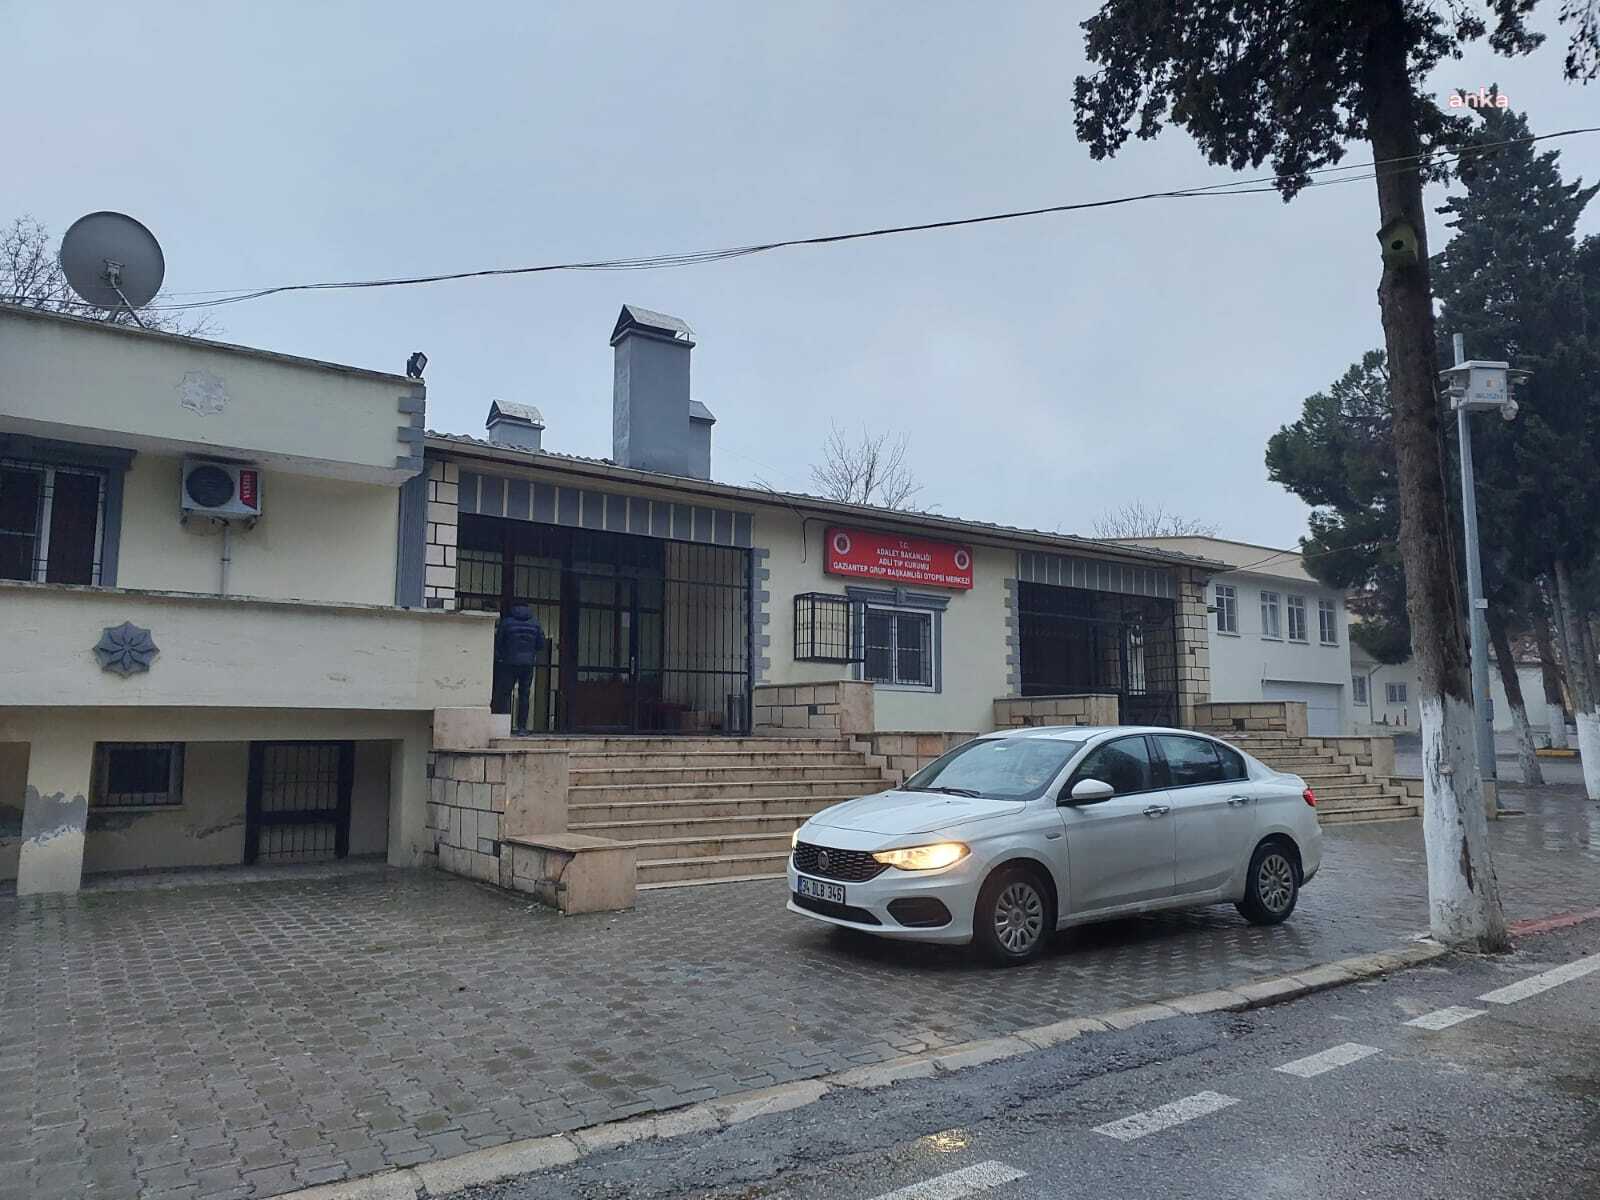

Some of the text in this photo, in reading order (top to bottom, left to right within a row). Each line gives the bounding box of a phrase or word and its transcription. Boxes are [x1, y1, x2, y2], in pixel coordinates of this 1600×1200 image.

[876, 548, 900, 557] ADALET
[894, 560, 904, 568] TIP
[904, 561, 930, 570] KURUMU
[870, 566, 886, 574] GRUP
[801, 880, 842, 901] 34 DLB 346
